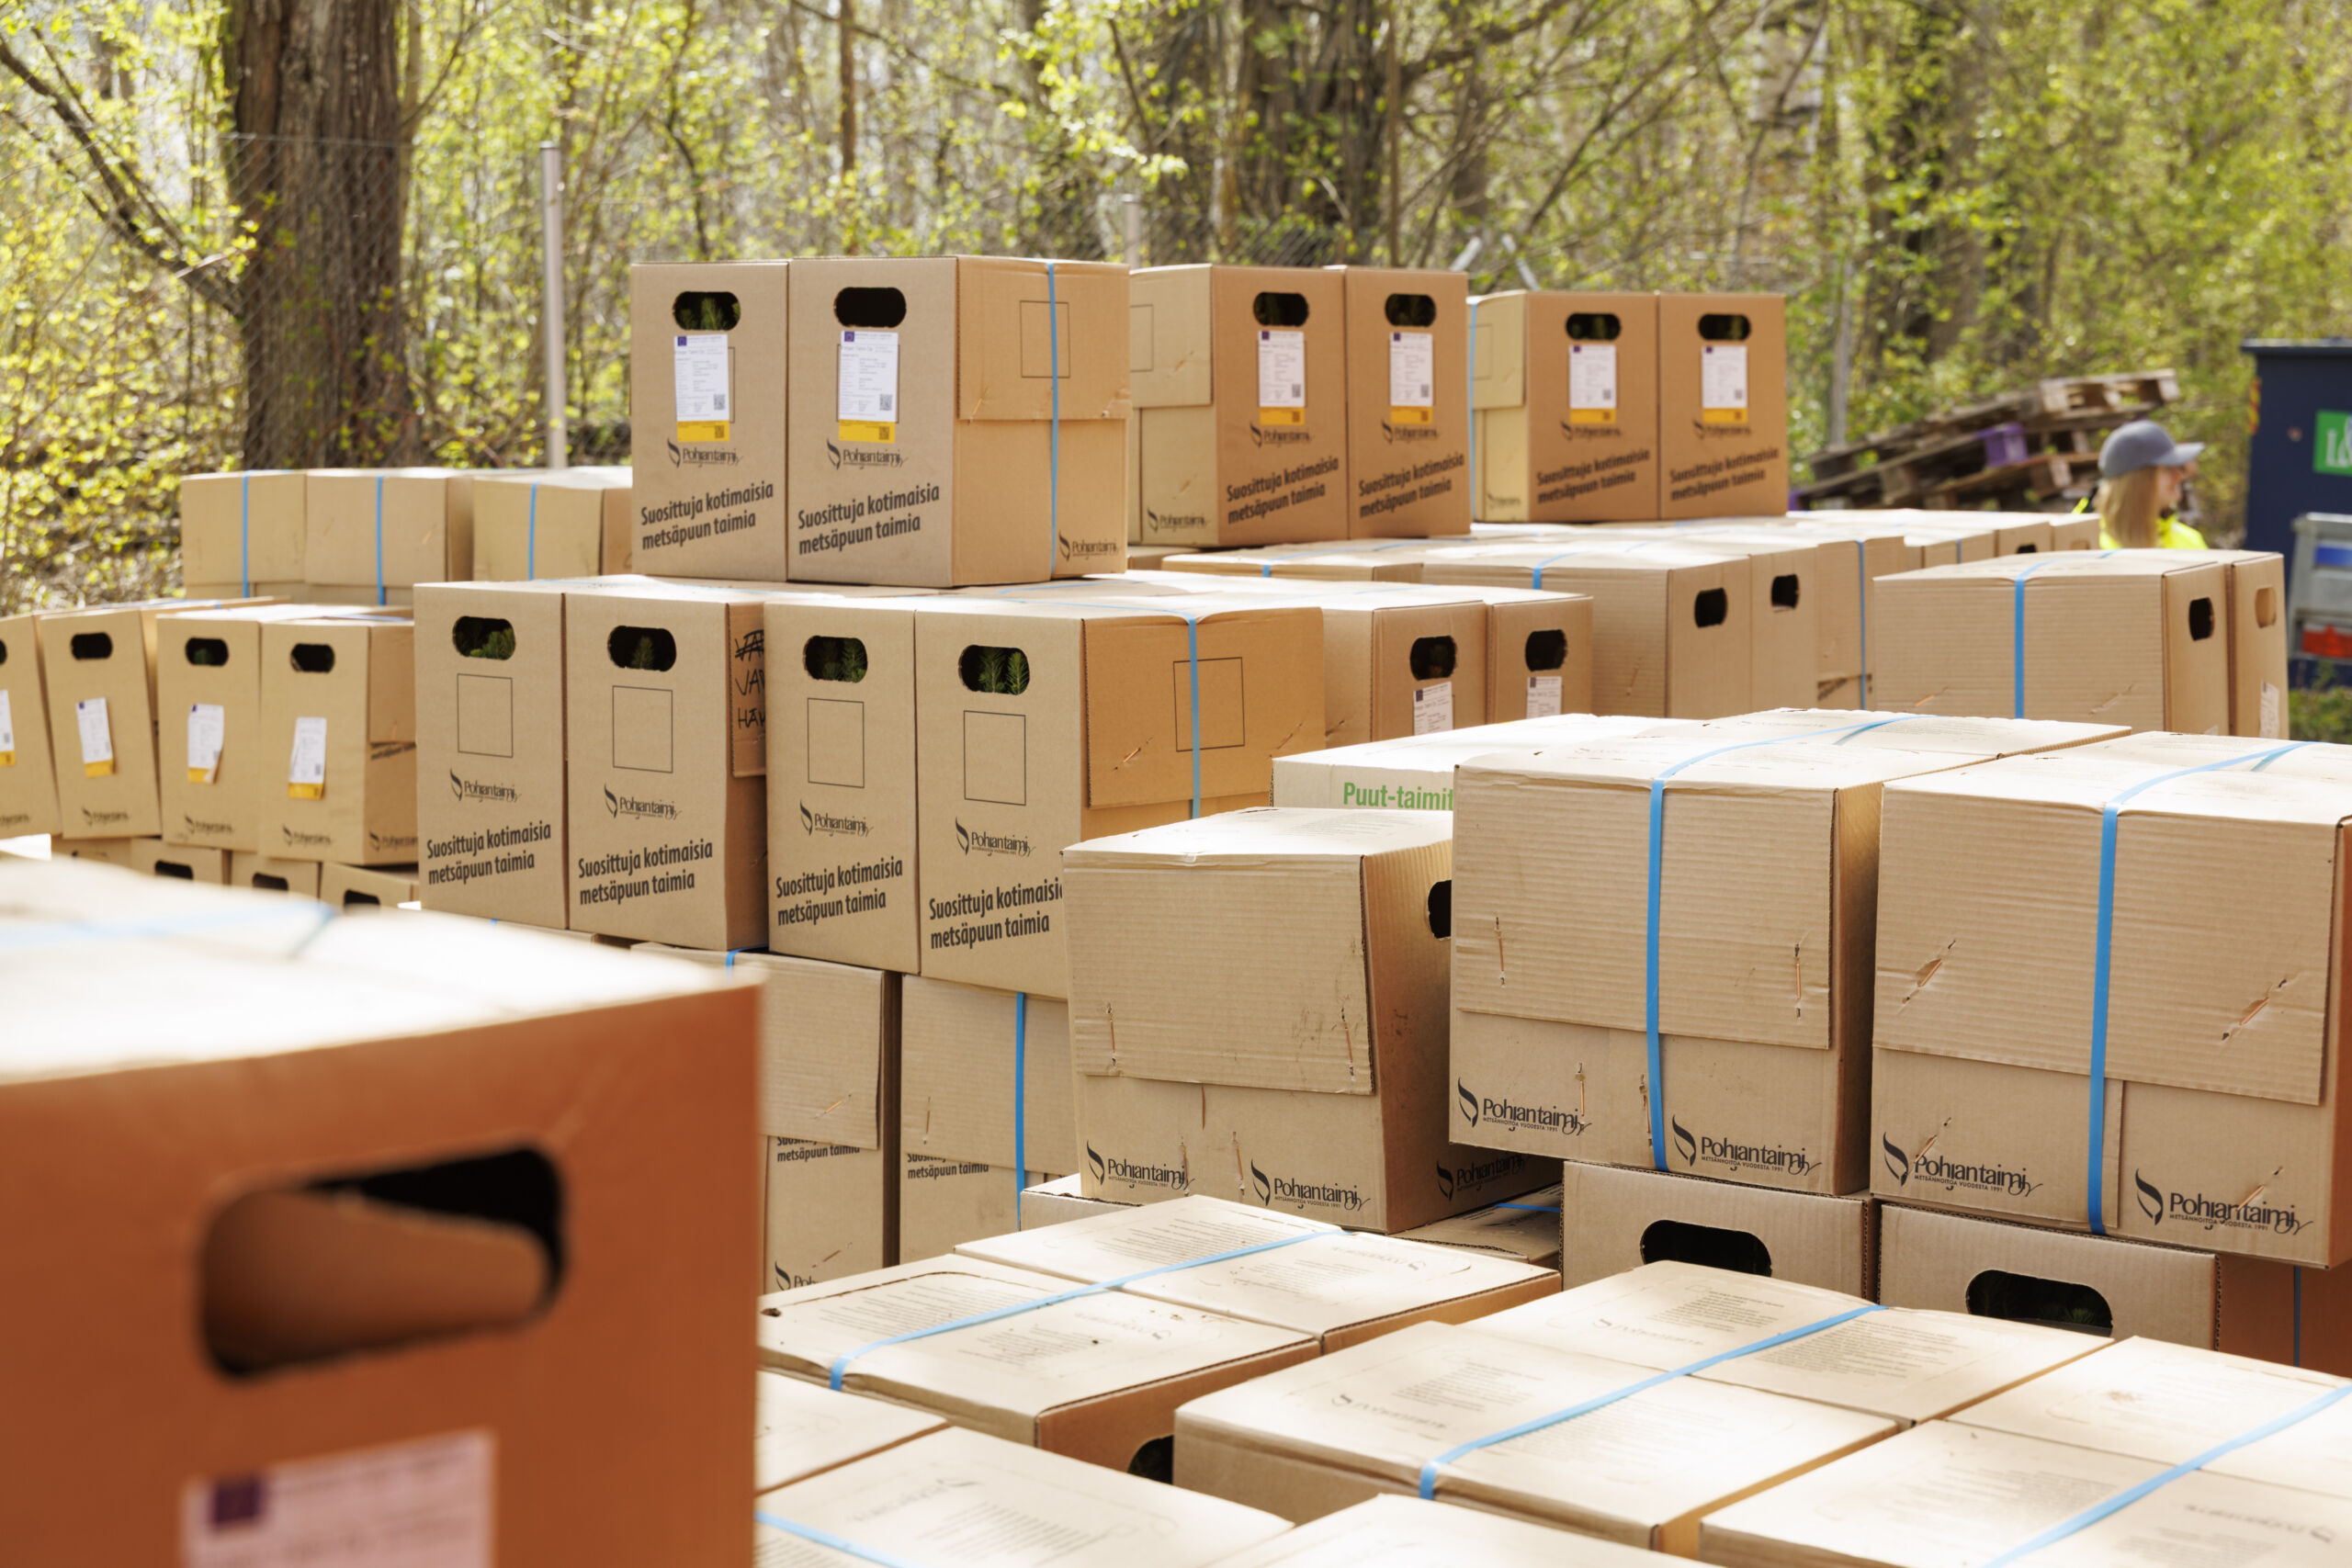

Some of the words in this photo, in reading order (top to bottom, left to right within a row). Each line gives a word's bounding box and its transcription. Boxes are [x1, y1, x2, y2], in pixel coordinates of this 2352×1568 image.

[1227, 472, 1283, 502] Suosittuja
[1283, 456, 1339, 485] kotimaisia
[1359, 468, 1412, 497] Suosittuja
[1413, 452, 1464, 479] kotimaisia
[641, 495, 704, 525] Suosittuja
[706, 480, 774, 511] kotimaisia
[798, 498, 865, 530] Suosittuja
[867, 482, 940, 515] kotimaisia
[1228, 493, 1289, 525] metsäpuun
[1291, 482, 1326, 506] taimia
[1359, 489, 1418, 518] metsäpuun
[1419, 477, 1453, 500] taimia
[642, 524, 711, 550] metsäpuun
[714, 509, 756, 536] taimia
[798, 526, 873, 556] metsäpuun
[876, 513, 921, 539] taimia
[426, 831, 484, 859] Suosittuja
[487, 819, 551, 850] kotimaisia
[578, 850, 641, 879] Suosittuja
[644, 838, 713, 868] kotimaisia
[429, 861, 492, 885] metsäpuun
[494, 850, 535, 874] taimia
[580, 879, 650, 906] metsäpuun
[651, 868, 695, 894] taimia
[776, 868, 835, 898] Suosittuja
[837, 855, 903, 887] kotimaisia
[778, 899, 843, 926] metsäpuun
[845, 888, 887, 914] taimia
[929, 889, 993, 919] Suosittuja
[931, 921, 1002, 950] metsäpuun
[1004, 910, 1050, 938] taimia
[1483, 1098, 1578, 1132] Pohjantaimi
[777, 1145, 828, 1163] metsäpuun
[908, 1164, 957, 1179] metsäpuun
[1702, 1136, 1806, 1171] Pohjantaimi
[1274, 1178, 1357, 1210] Pohjantaimi
